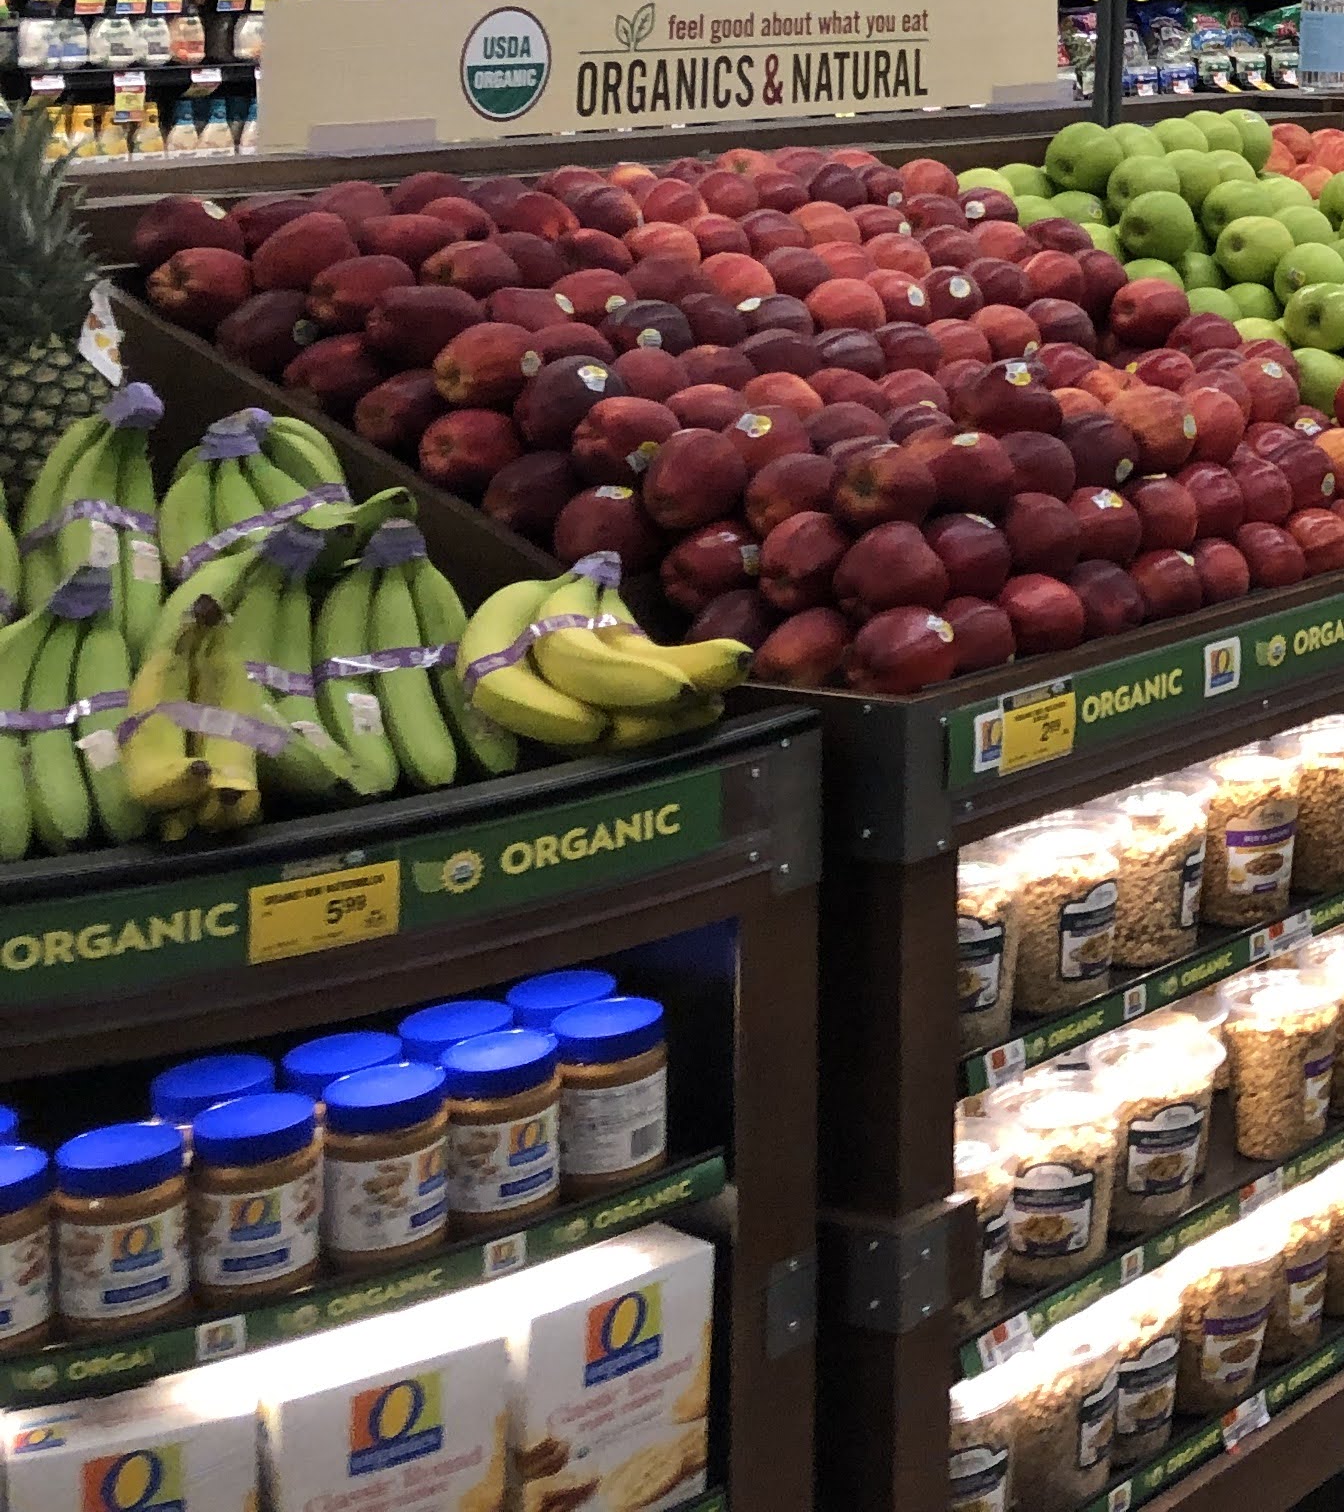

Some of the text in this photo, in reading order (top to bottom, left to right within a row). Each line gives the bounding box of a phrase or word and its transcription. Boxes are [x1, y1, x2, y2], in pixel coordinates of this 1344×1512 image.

[483, 35, 531, 59] USDA
[668, 9, 929, 44] feel good about what you eat
[474, 68, 537, 89] ORGANIC
[576, 48, 929, 117] ORGANICS & NATURAL
[1082, 668, 1183, 723] ORGANIC
[500, 803, 681, 875] ORGANIC
[0, 902, 240, 971] ORGANIC
